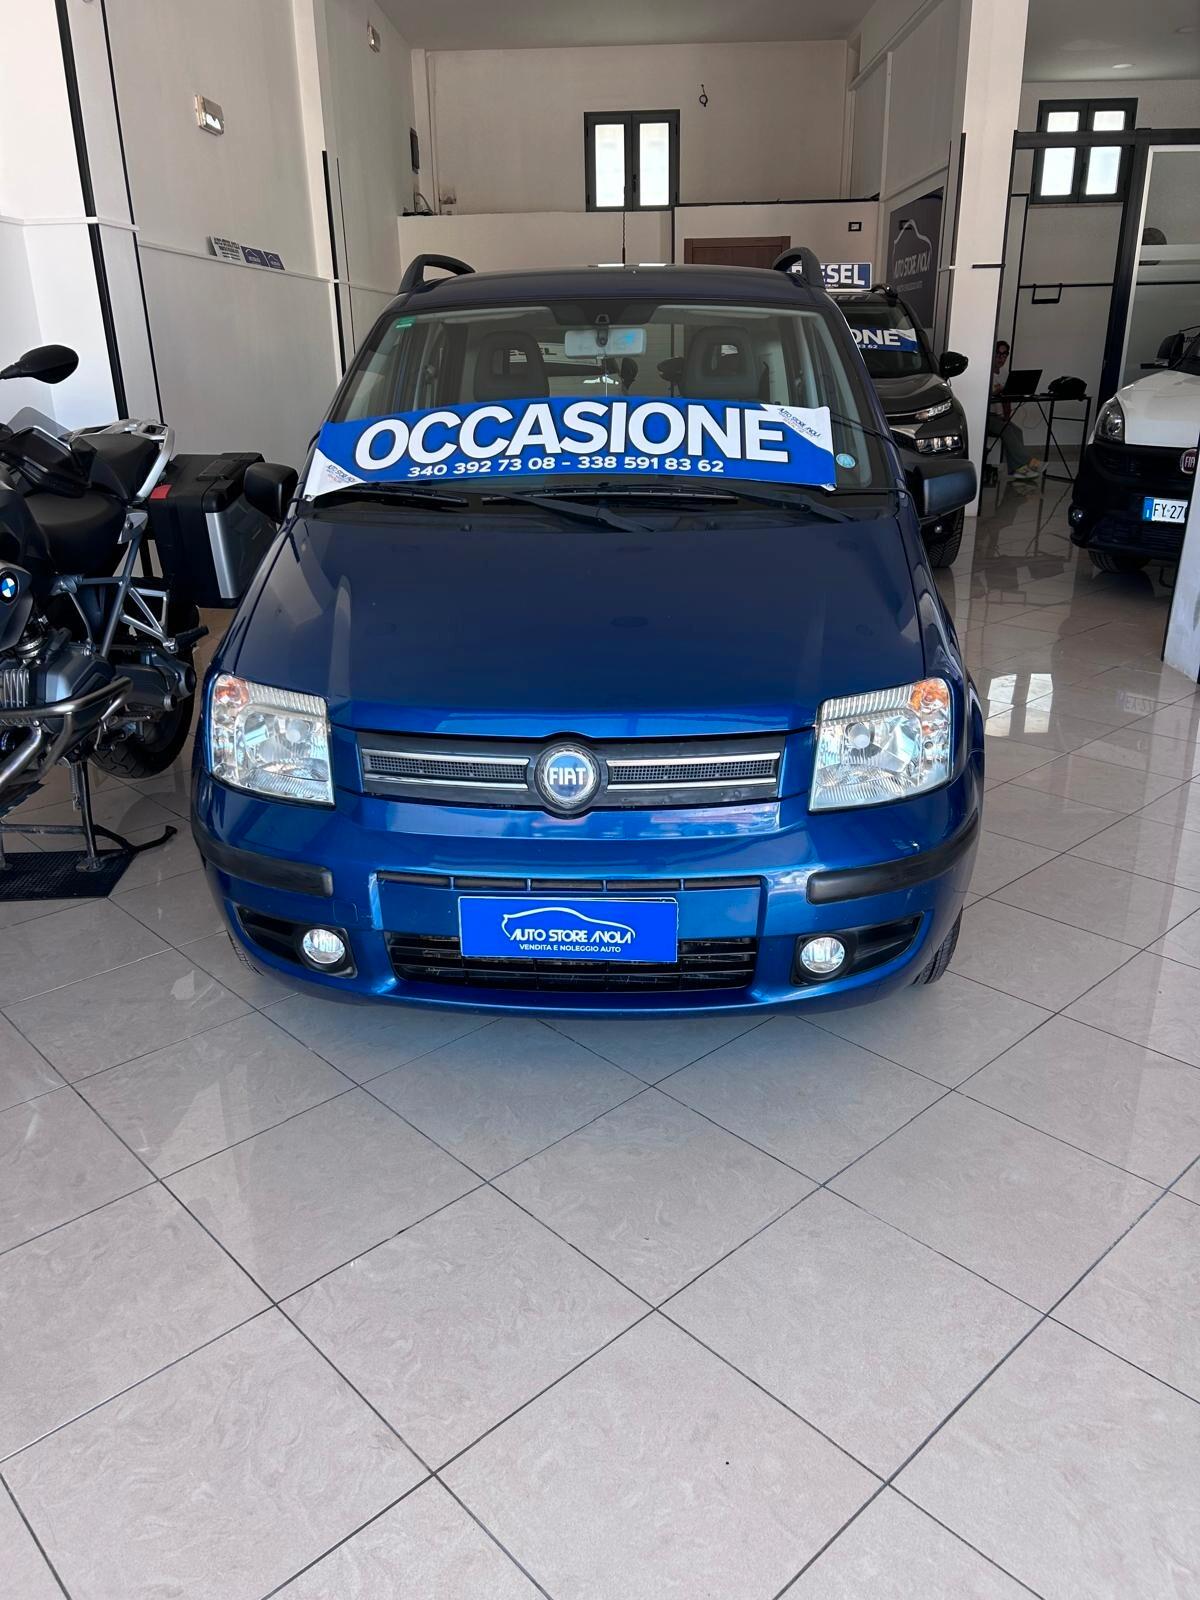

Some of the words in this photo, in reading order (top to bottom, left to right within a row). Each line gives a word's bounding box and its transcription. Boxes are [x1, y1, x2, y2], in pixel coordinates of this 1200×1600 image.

[355, 401, 789, 470] OCCASIONE
[407, 464, 448, 478] 340
[453, 462, 492, 475] 392
[498, 459, 522, 471] 73
[528, 457, 556, 470] 08
[577, 456, 617, 469] 338
[624, 457, 658, 470] 591
[664, 458, 691, 471] 83
[697, 459, 724, 473] 62
[1184, 456, 1196, 468] FIA
[1152, 503, 1168, 517] FY
[1169, 505, 1187, 520] 27
[549, 767, 587, 785] FIAT
[510, 928, 547, 941] AUTO
[548, 929, 588, 943] STORE
[519, 943, 552, 951] VENDITA
